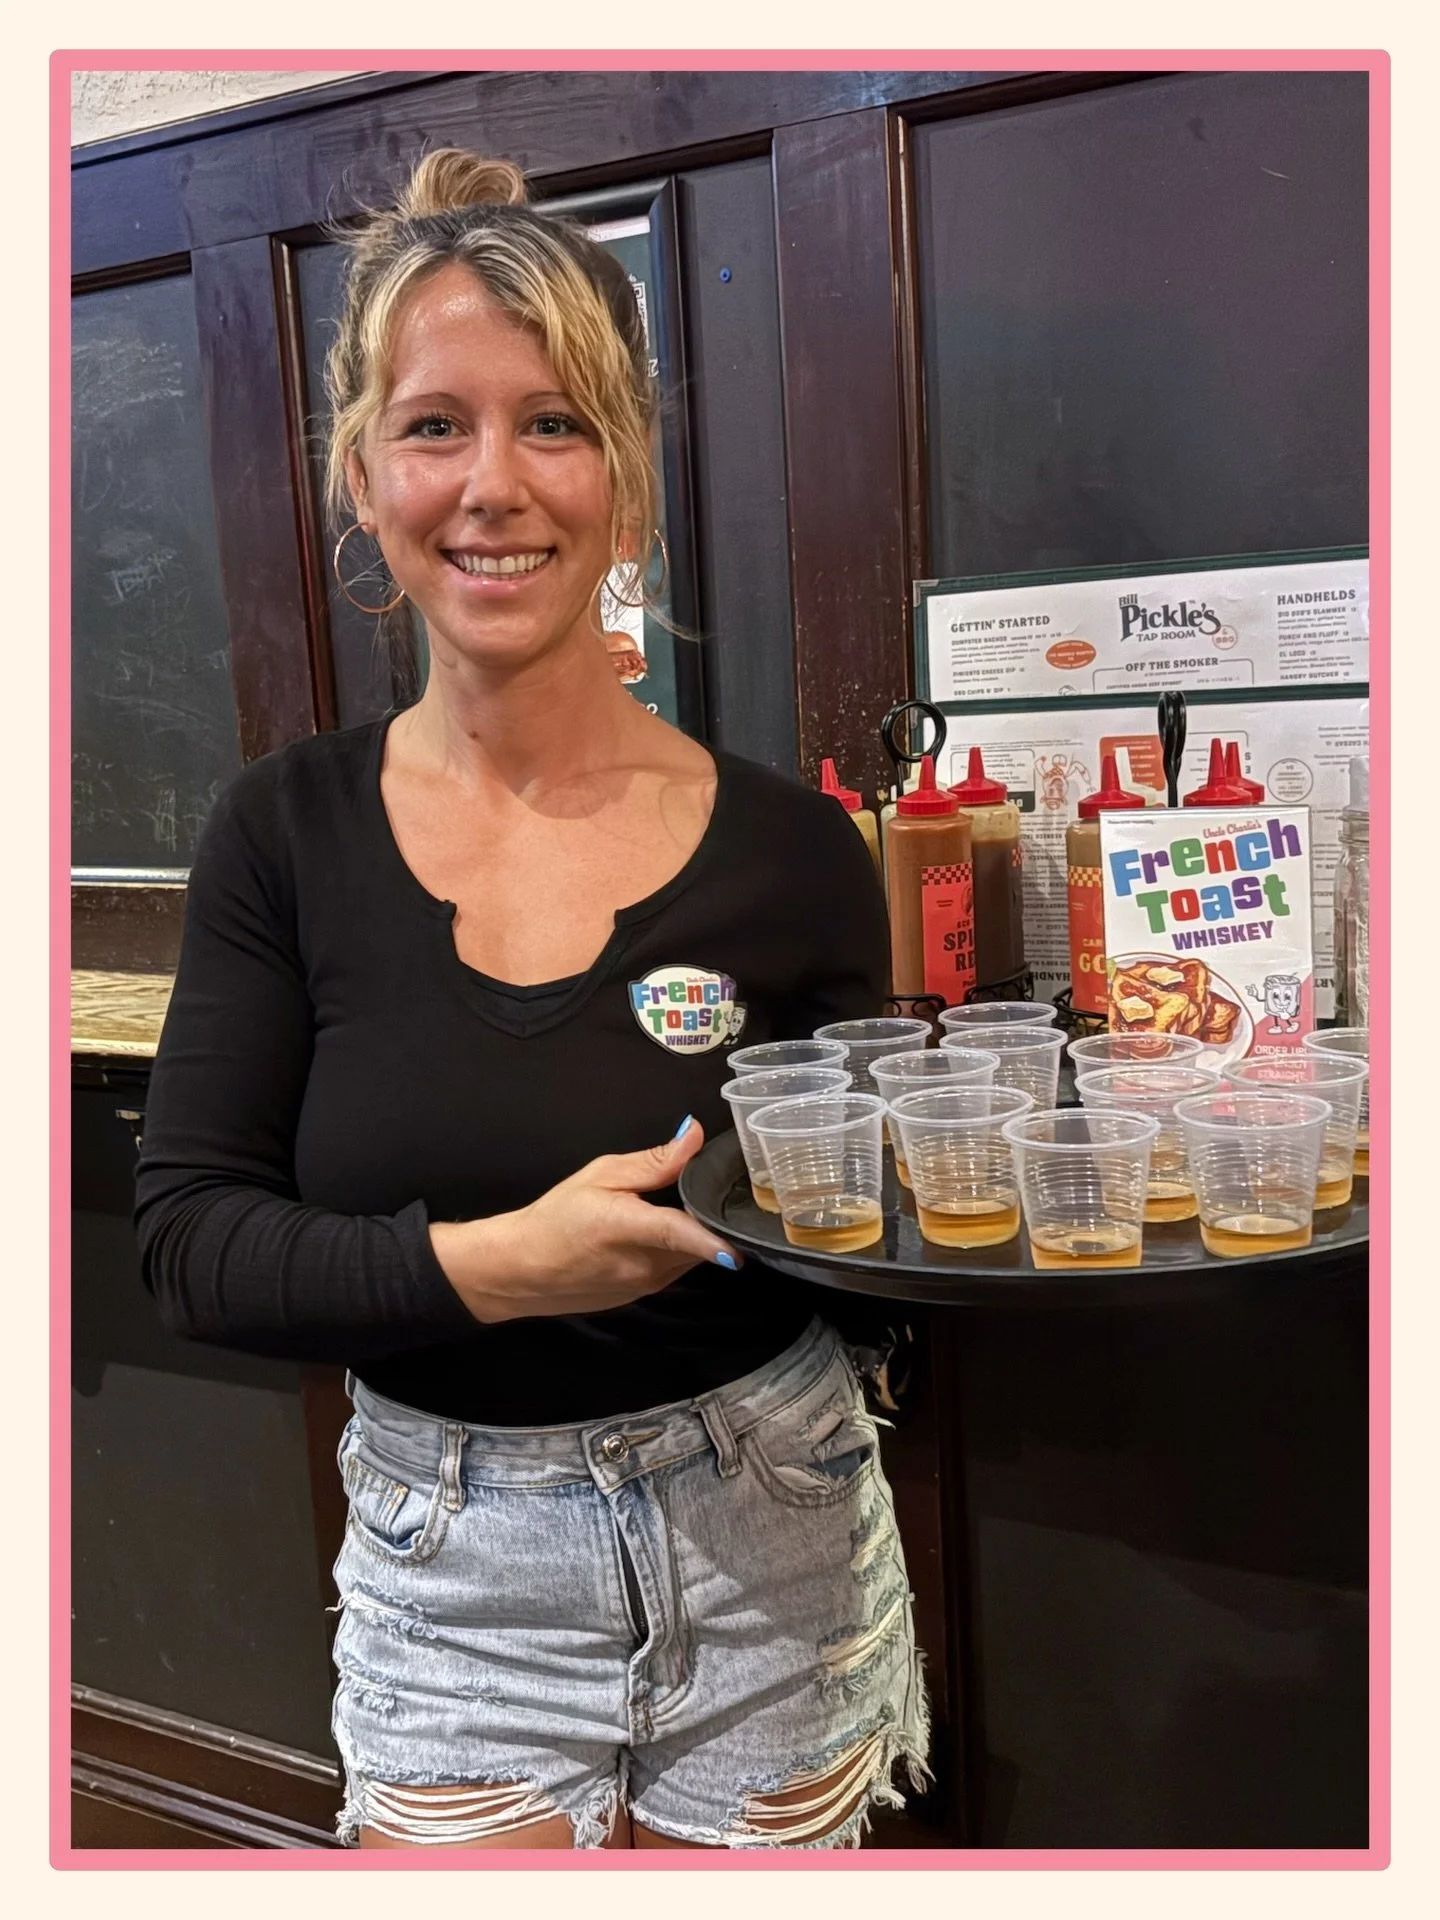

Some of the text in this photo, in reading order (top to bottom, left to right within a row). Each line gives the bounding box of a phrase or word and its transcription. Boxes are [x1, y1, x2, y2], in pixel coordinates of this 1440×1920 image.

[1118, 593, 1138, 606] Bill
[1277, 589, 1356, 605] HANDHELDS
[951, 615, 1050, 633] GETTIN' STARTED
[1120, 601, 1222, 642] Pickle's
[1136, 630, 1196, 642] TAP ROOM
[1125, 656, 1219, 672] OFF THE SMOKER
[1109, 818, 1302, 897] French
[1136, 873, 1290, 934] Toast
[1172, 920, 1275, 950] WHISKEY
[632, 975, 736, 1010] French
[647, 1008, 722, 1034] Toast
[665, 1034, 712, 1046] WHISKEY
[1254, 1045, 1287, 1055] ORDER
